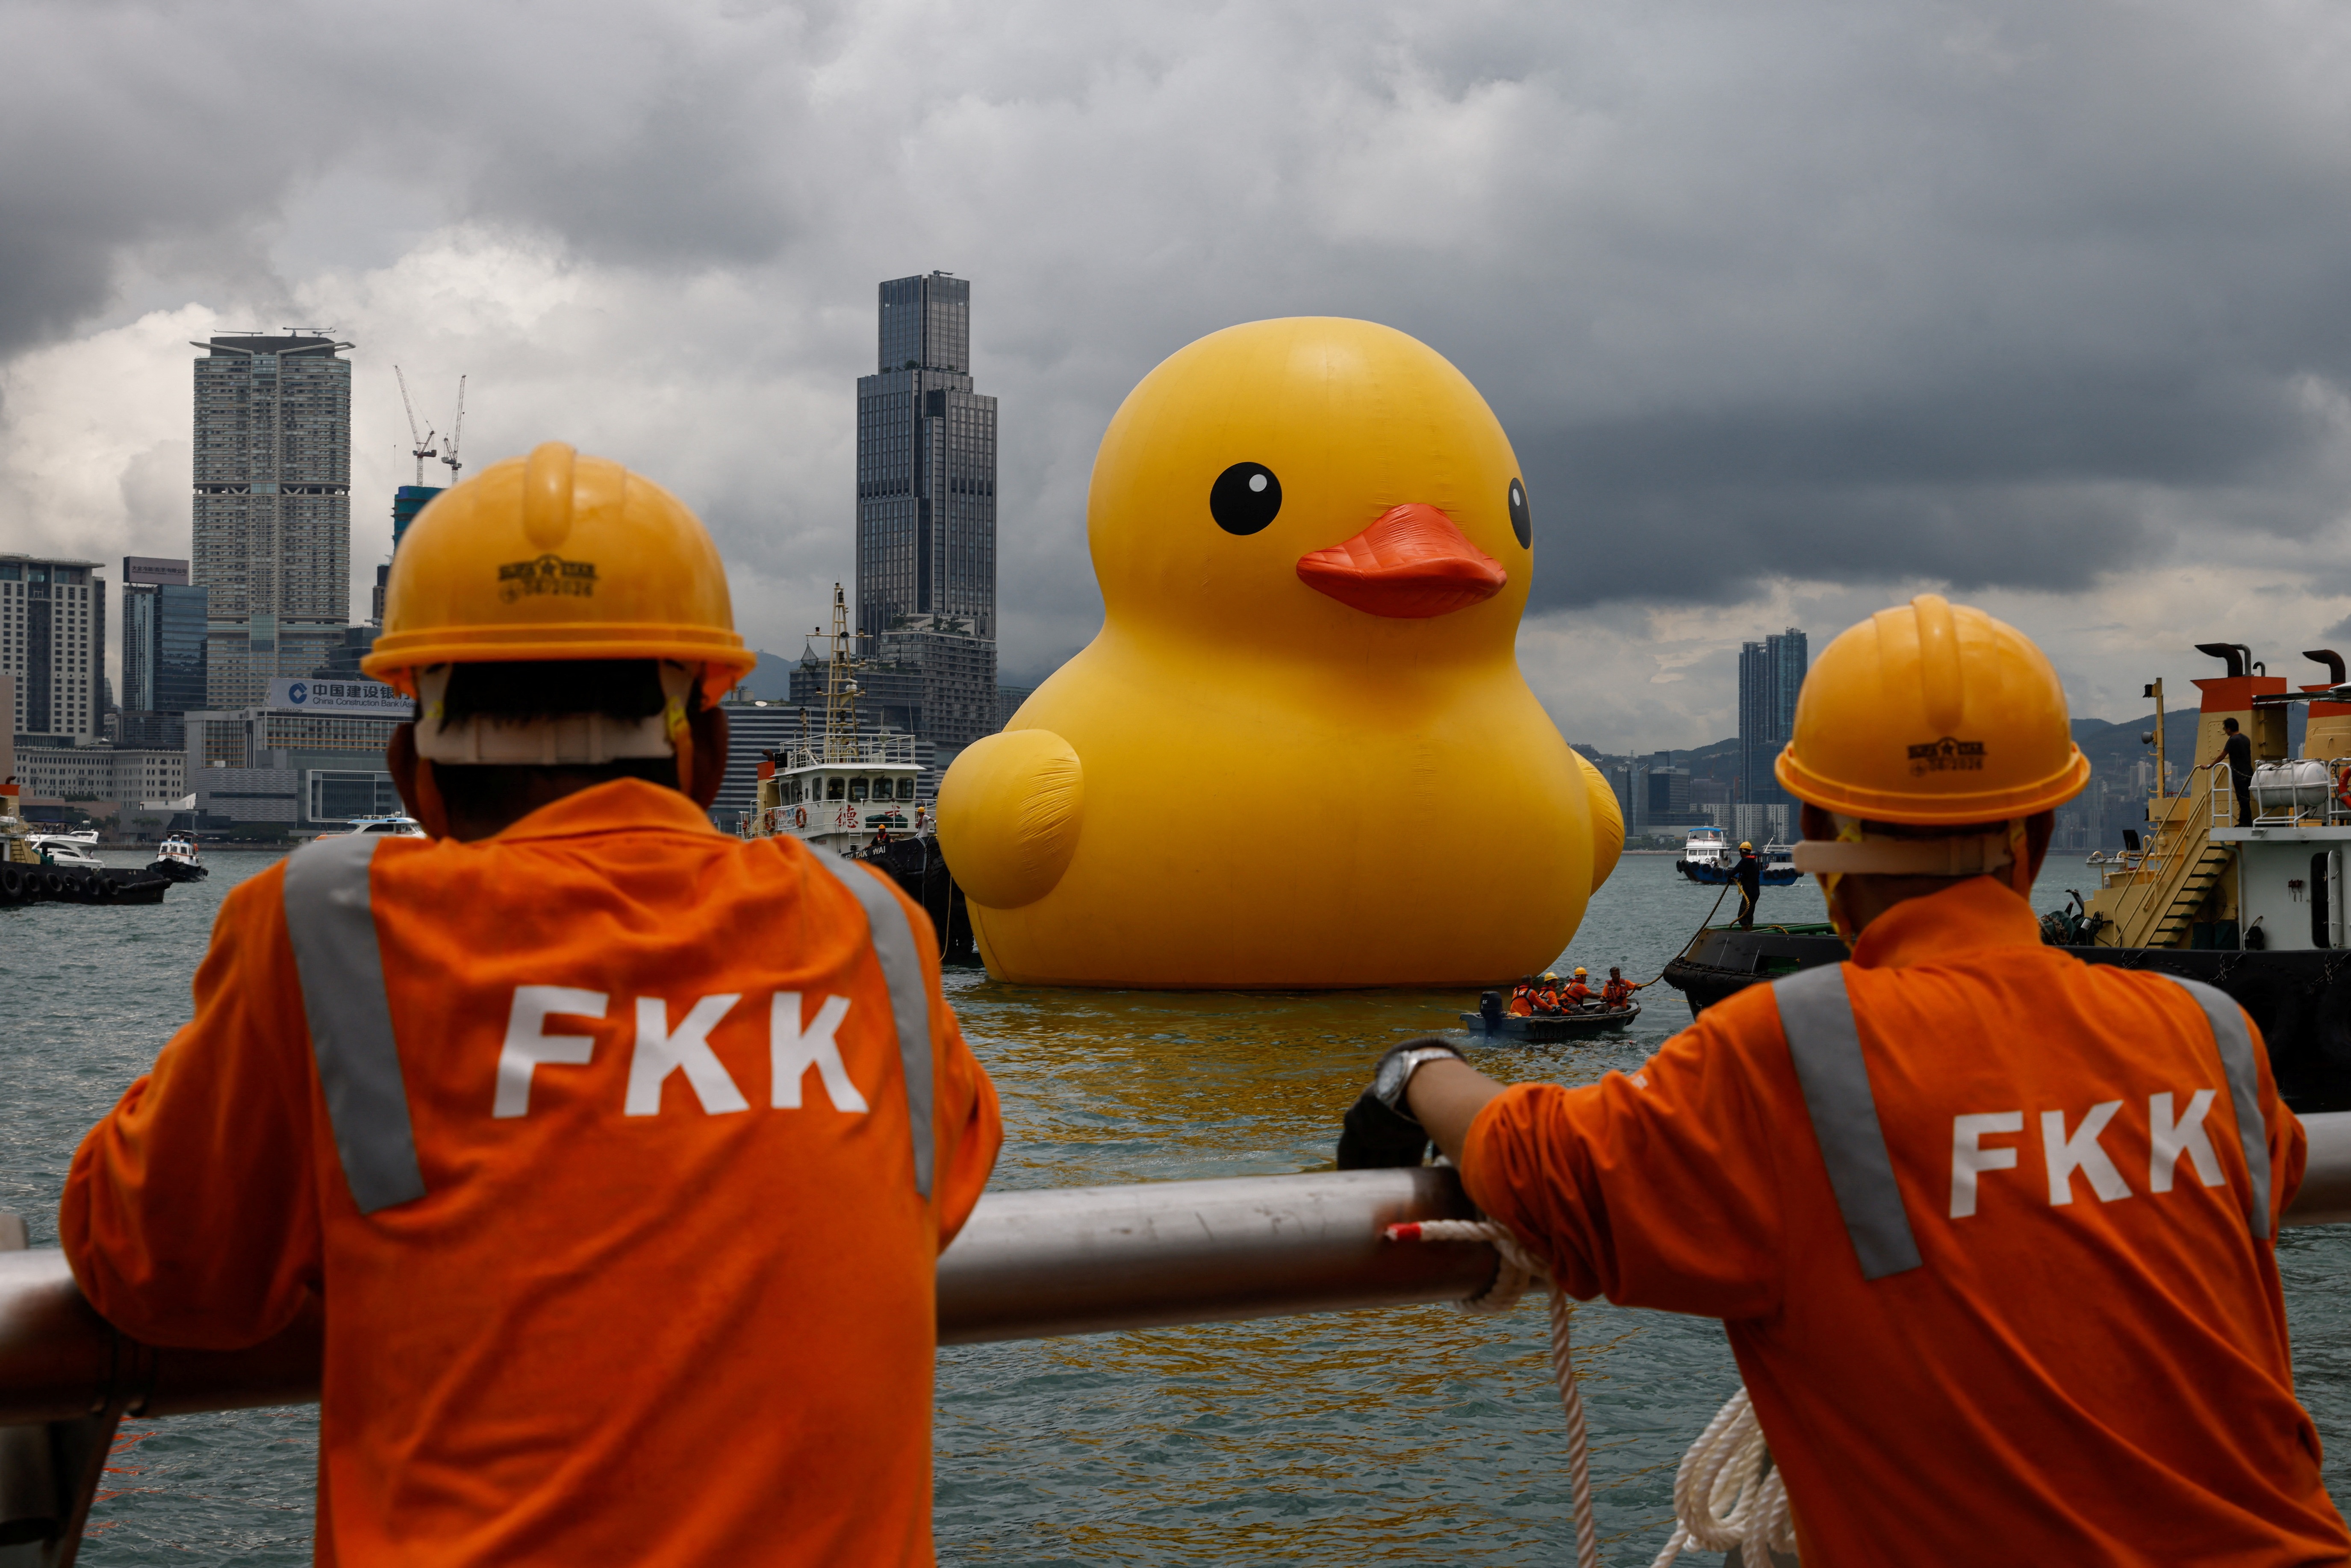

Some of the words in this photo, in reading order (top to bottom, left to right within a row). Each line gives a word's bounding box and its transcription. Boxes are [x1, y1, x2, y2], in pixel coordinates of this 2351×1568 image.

[336, 698, 379, 706] Construction
[855, 850, 868, 859] TAK
[873, 845, 886, 855] WAI
[492, 985, 869, 1119] FKK
[1950, 1089, 2226, 1219] FKK
